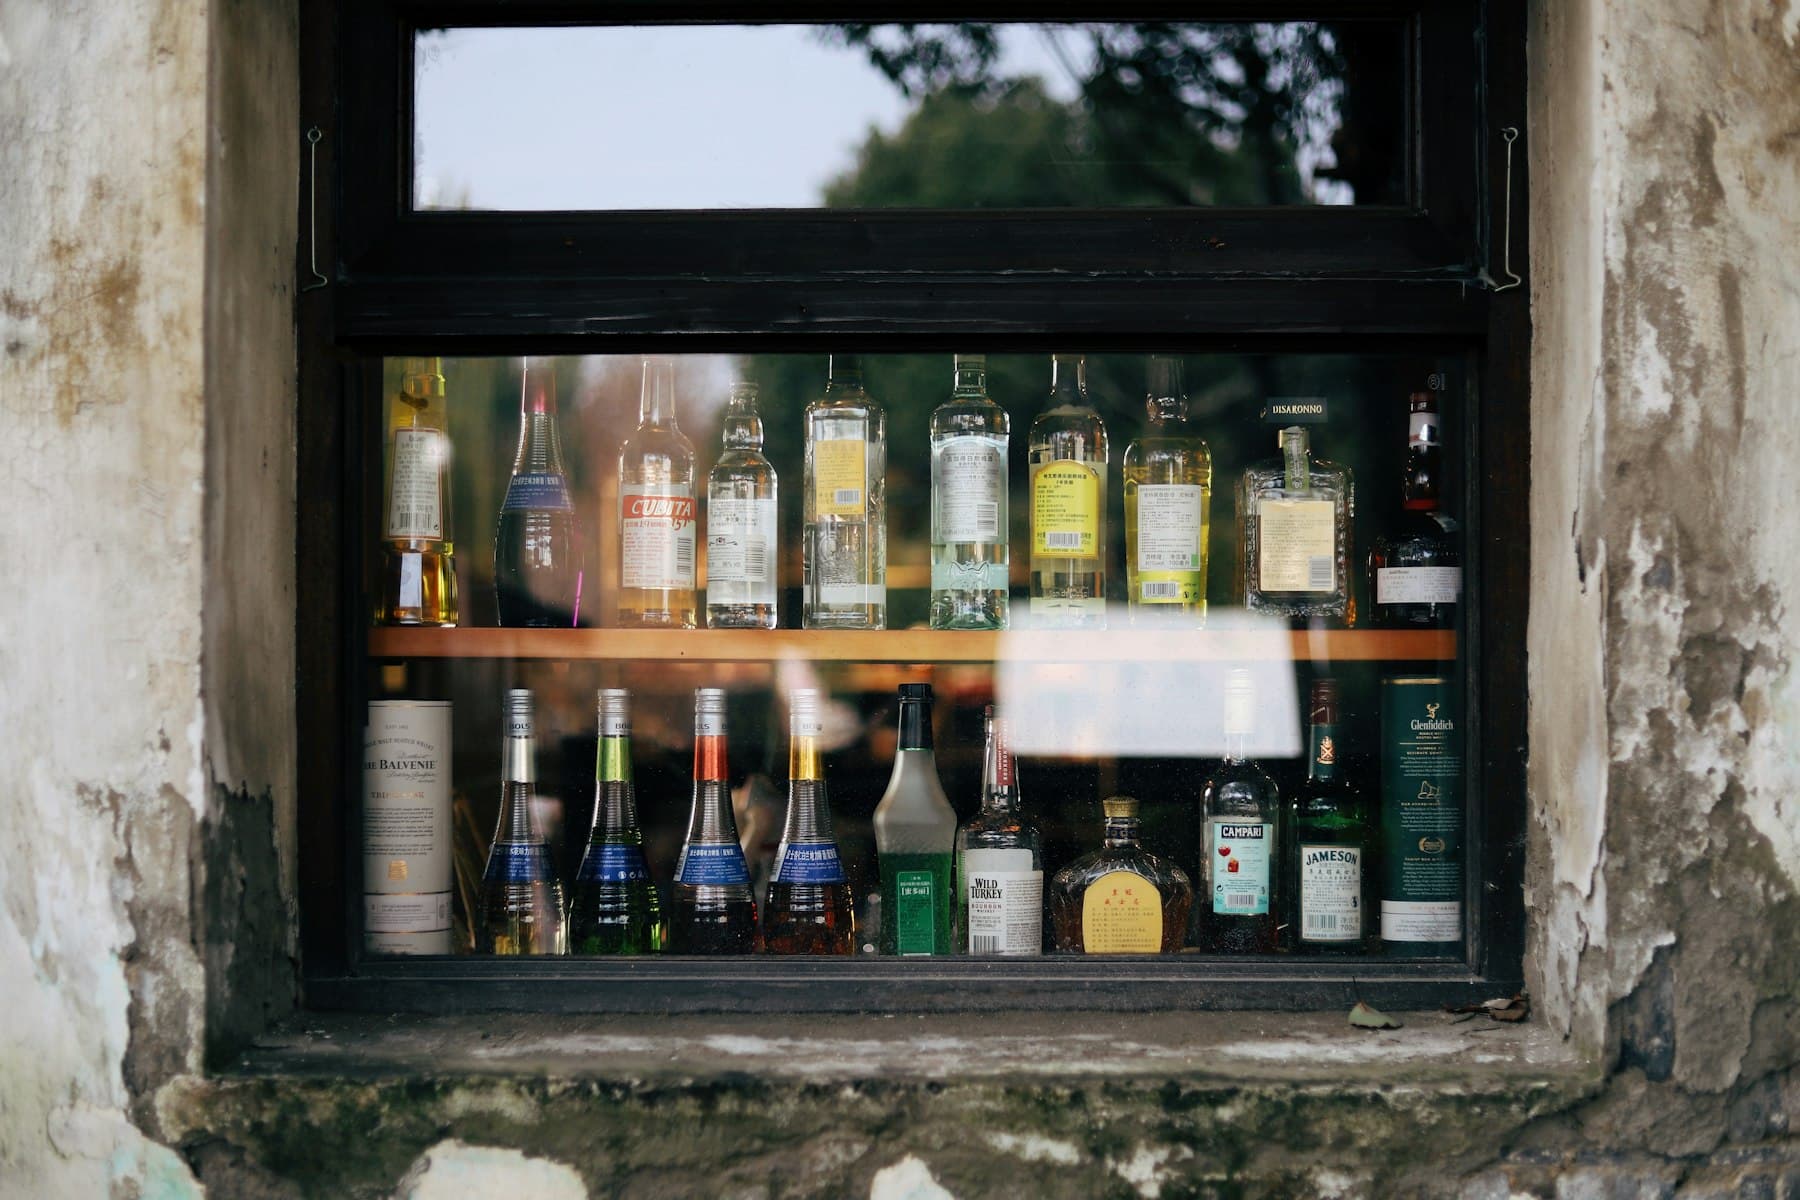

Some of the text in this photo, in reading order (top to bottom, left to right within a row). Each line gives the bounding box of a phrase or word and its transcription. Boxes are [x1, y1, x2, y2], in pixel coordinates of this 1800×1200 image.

[1272, 404, 1322, 415] DISARONNO
[630, 499, 692, 517] CUBITA
[1410, 719, 1454, 731] Glenfiddich
[380, 759, 437, 770] BALVENIE
[1222, 826, 1262, 837] CAMPARI
[1306, 850, 1358, 866] JAMESON
[975, 878, 998, 889] WILD
[970, 886, 1003, 900] TURKEY
